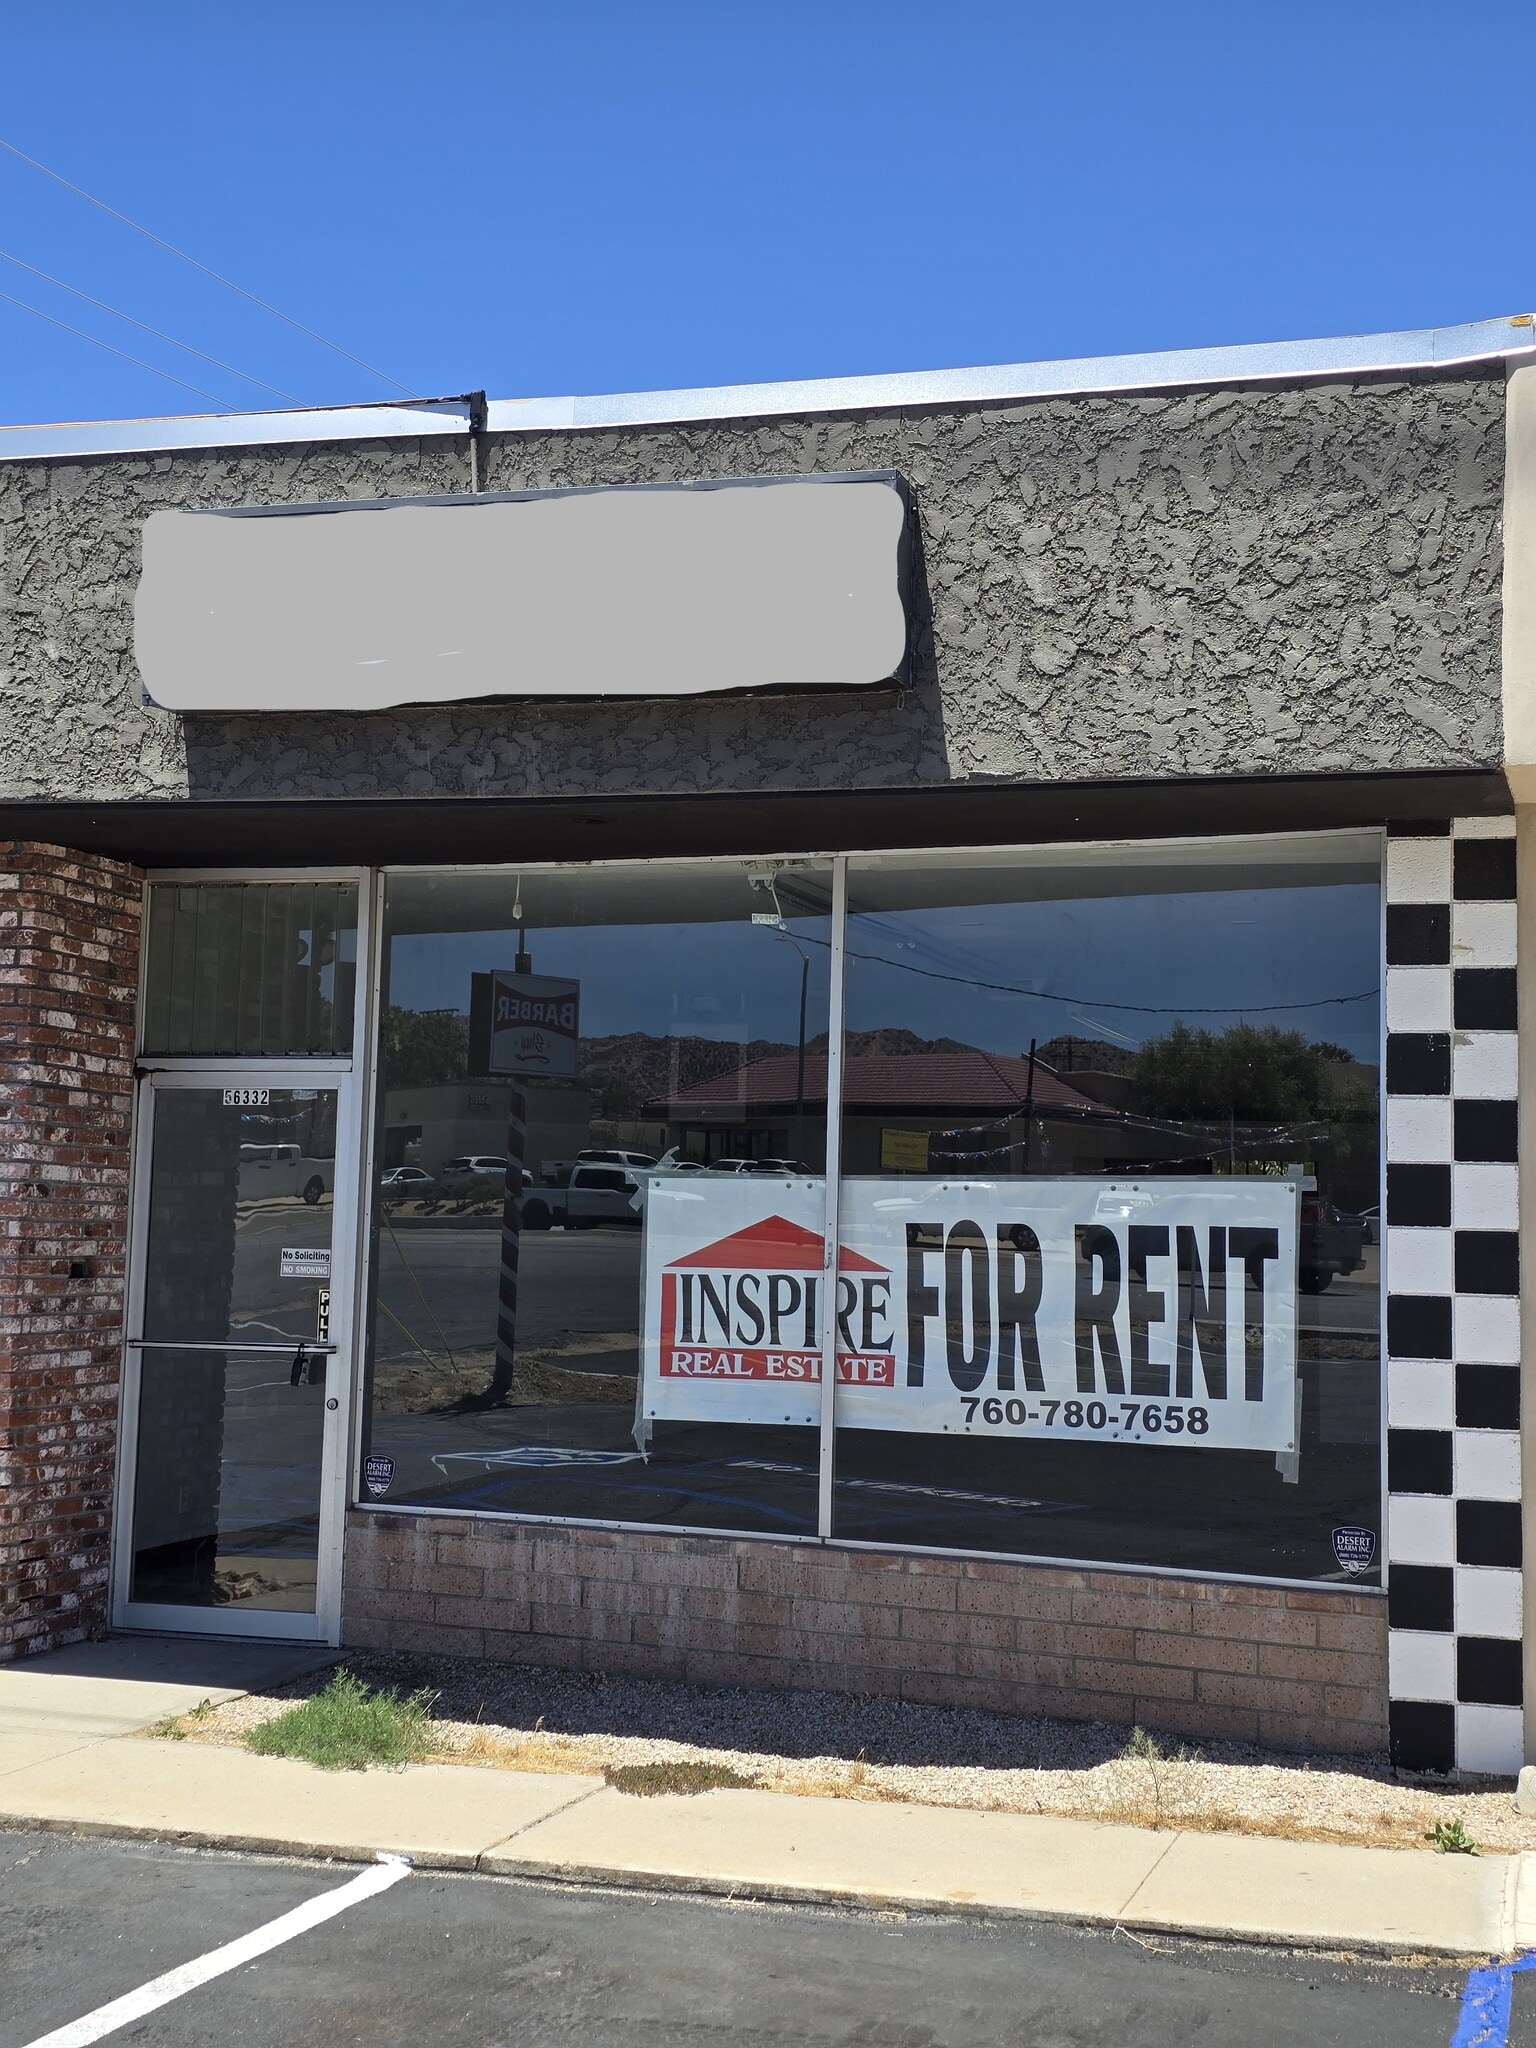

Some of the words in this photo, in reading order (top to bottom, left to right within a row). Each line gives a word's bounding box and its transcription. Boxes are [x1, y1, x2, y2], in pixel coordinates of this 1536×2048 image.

[224, 1090, 269, 1105] 56332
[283, 1251, 293, 1260] No
[294, 1251, 330, 1263] Soliciting
[283, 1266, 293, 1274] NO
[295, 1266, 328, 1275] SMOKING
[320, 1292, 330, 1343] PULL
[905, 1219, 1047, 1392] FOR
[1074, 1223, 1280, 1403] RENT
[670, 1351, 753, 1377] REAL
[766, 1354, 888, 1383] ESTTE
[960, 1396, 1210, 1435] 760-780-7658
[367, 1462, 392, 1472] DESERT
[1337, 1535, 1371, 1547] DESERT
